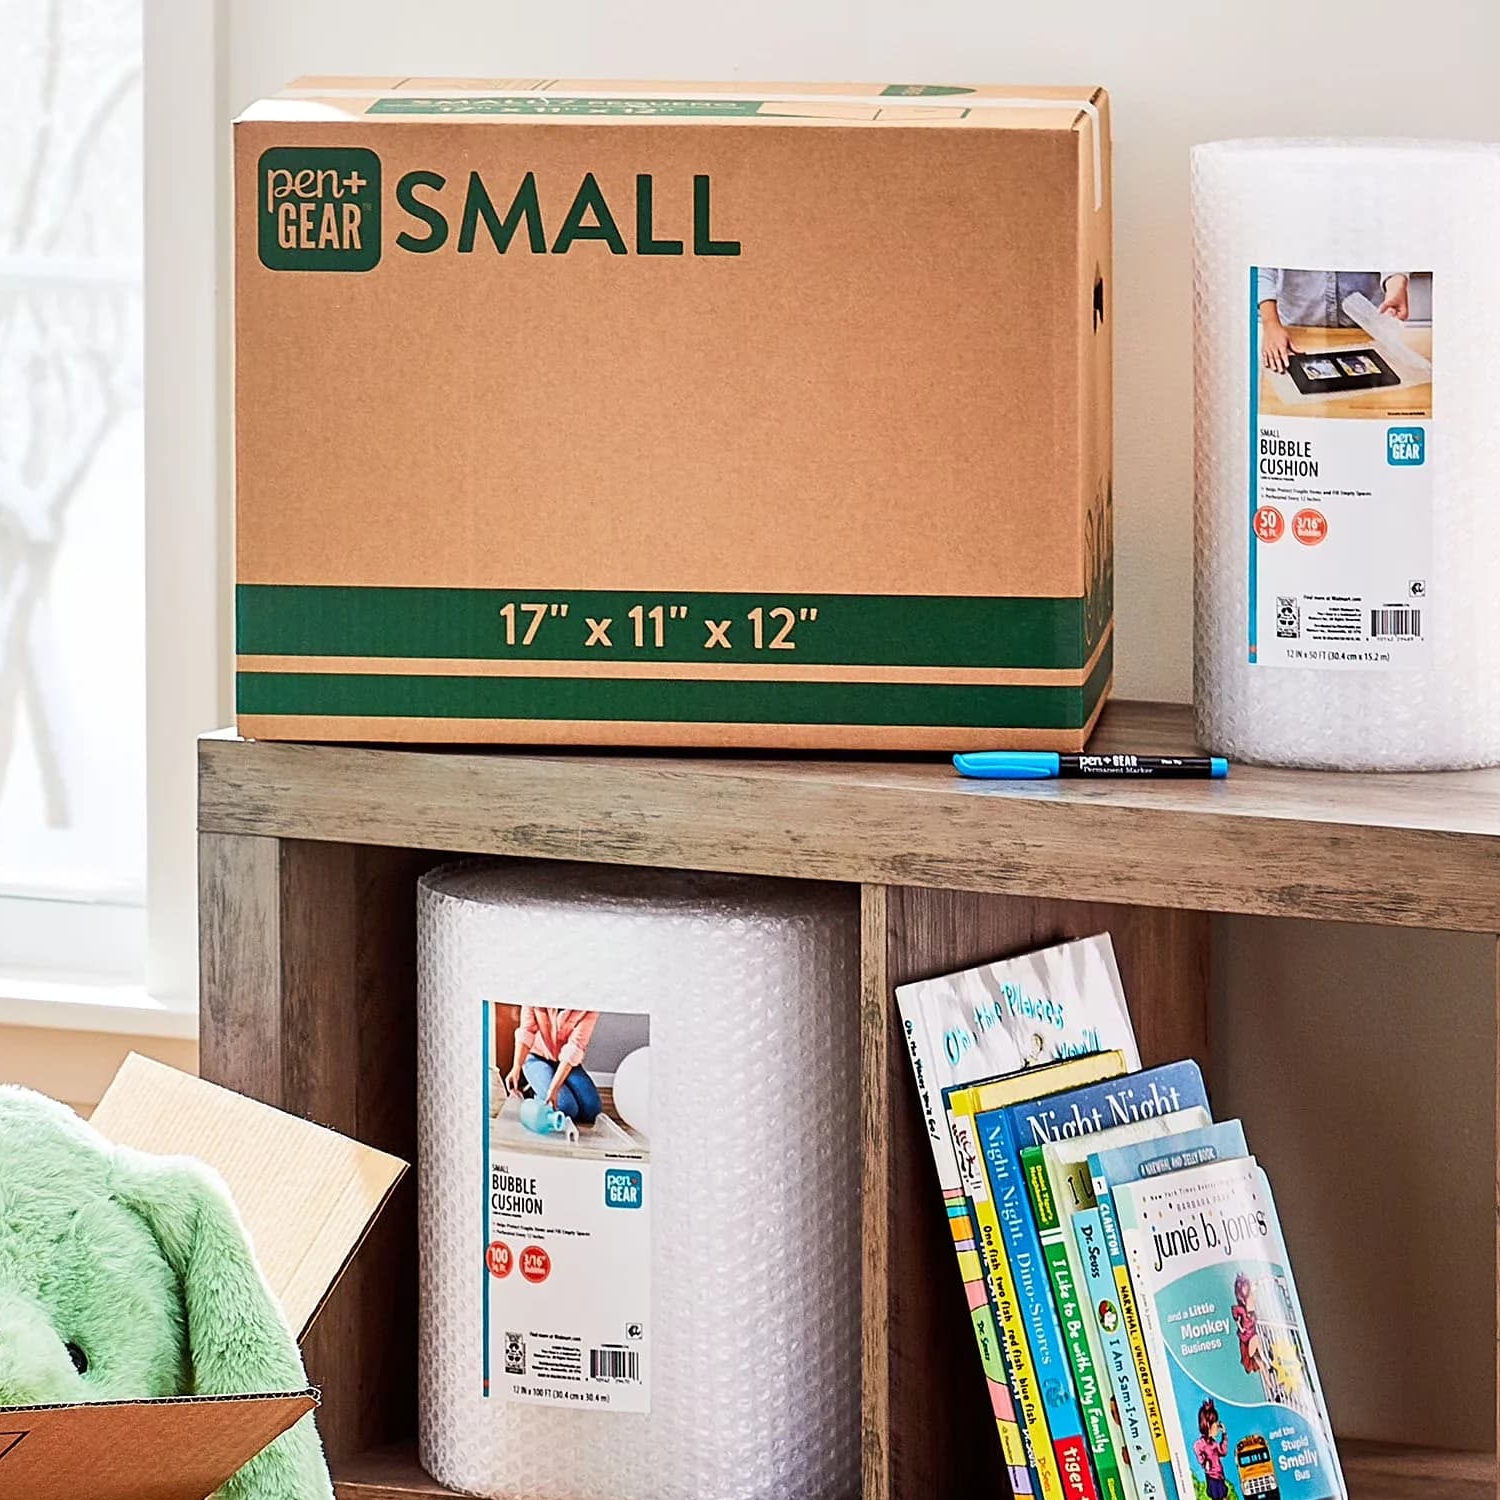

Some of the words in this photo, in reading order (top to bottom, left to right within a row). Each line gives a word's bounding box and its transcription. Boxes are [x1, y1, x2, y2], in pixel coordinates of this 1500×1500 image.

[396, 170, 741, 256] SMALL
[277, 203, 363, 250] GEAR
[1260, 439, 1312, 458] BUBBLE
[1393, 443, 1420, 460] GEAR
[1260, 459, 1319, 478] CUSHION
[1260, 511, 1277, 528] 50
[499, 602, 569, 646] 17"
[585, 618, 612, 647] x
[628, 605, 688, 647] 11"
[704, 619, 732, 649] x
[747, 606, 818, 649] 12"
[1286, 649, 1294, 658] 12
[1112, 755, 1137, 767] GEAR
[973, 999, 1003, 1034] the
[1000, 981, 1065, 1031] Places
[1027, 1104, 1102, 1146] Night
[1106, 1084, 1180, 1124] Night
[492, 1173, 537, 1195] BUBBLE
[610, 1185, 637, 1202] GEAR
[491, 1193, 542, 1215] CUSHION
[983, 1226, 993, 1246] One
[1100, 1203, 1120, 1256] CLANTON
[987, 1126, 1009, 1179] Night
[1017, 1251, 1052, 1366] Dino-Snores
[1082, 1224, 1093, 1245] Dr.
[1088, 1246, 1100, 1279] Seuss
[1152, 1219, 1200, 1272] junie
[1200, 1212, 1221, 1248] b.
[1220, 1210, 1267, 1256] jones
[490, 1247, 508, 1264] 100
[989, 1250, 1001, 1270] fish
[1053, 1258, 1067, 1268] I
[995, 1276, 1006, 1298] two
[1054, 1271, 1074, 1300] Like
[1002, 1301, 1013, 1322] fish
[1064, 1303, 1074, 1318] to
[1168, 1311, 1182, 1322] and
[1188, 1302, 1215, 1317] Little
[1008, 1329, 1019, 1346] red
[1067, 1320, 1081, 1339] Be
[1181, 1317, 1230, 1340] Monkey
[1110, 1339, 1120, 1347] I
[1181, 1338, 1222, 1356] Business
[1013, 1349, 1025, 1371] fish
[1071, 1342, 1090, 1373] with
[1112, 1351, 1124, 1372] Am
[1134, 1345, 1149, 1384] UNICORN
[1019, 1378, 1029, 1400] blue
[1081, 1375, 1095, 1405] My
[1144, 1388, 1153, 1397] OF
[1025, 1403, 1037, 1425] fish
[1118, 1375, 1139, 1440] Sam-I-Am
[1147, 1399, 1157, 1420] THE
[1088, 1408, 1109, 1454] Family
[1152, 1421, 1162, 1439] SEA
[1269, 1429, 1282, 1440] and
[1283, 1426, 1296, 1436] the
[1281, 1436, 1309, 1452] Stupid
[1063, 1446, 1084, 1493] tiger
[1278, 1448, 1319, 1471] Smelly
[1294, 1470, 1311, 1481] Bus
